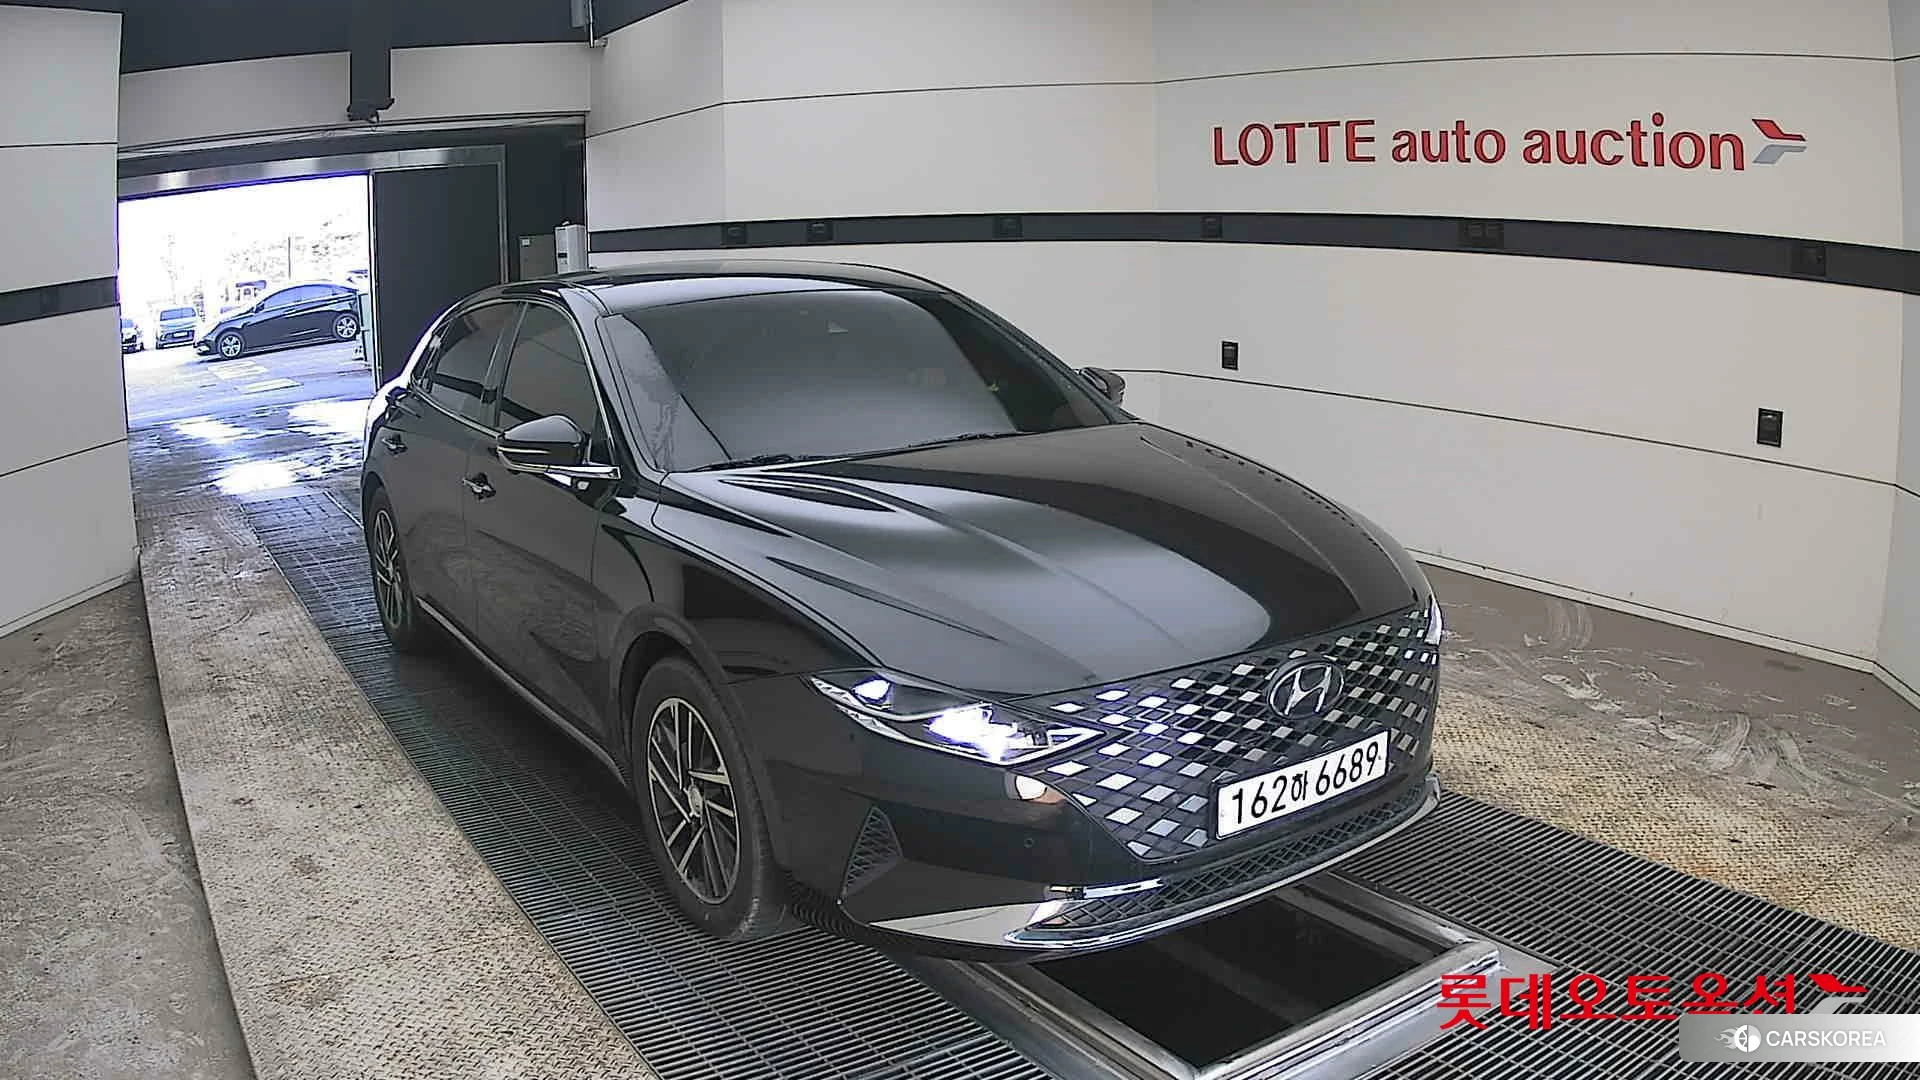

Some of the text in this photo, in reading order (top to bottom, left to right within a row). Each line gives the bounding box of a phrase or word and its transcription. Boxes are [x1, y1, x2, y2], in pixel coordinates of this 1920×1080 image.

[1213, 112, 1746, 171] LOTTE auto auction
